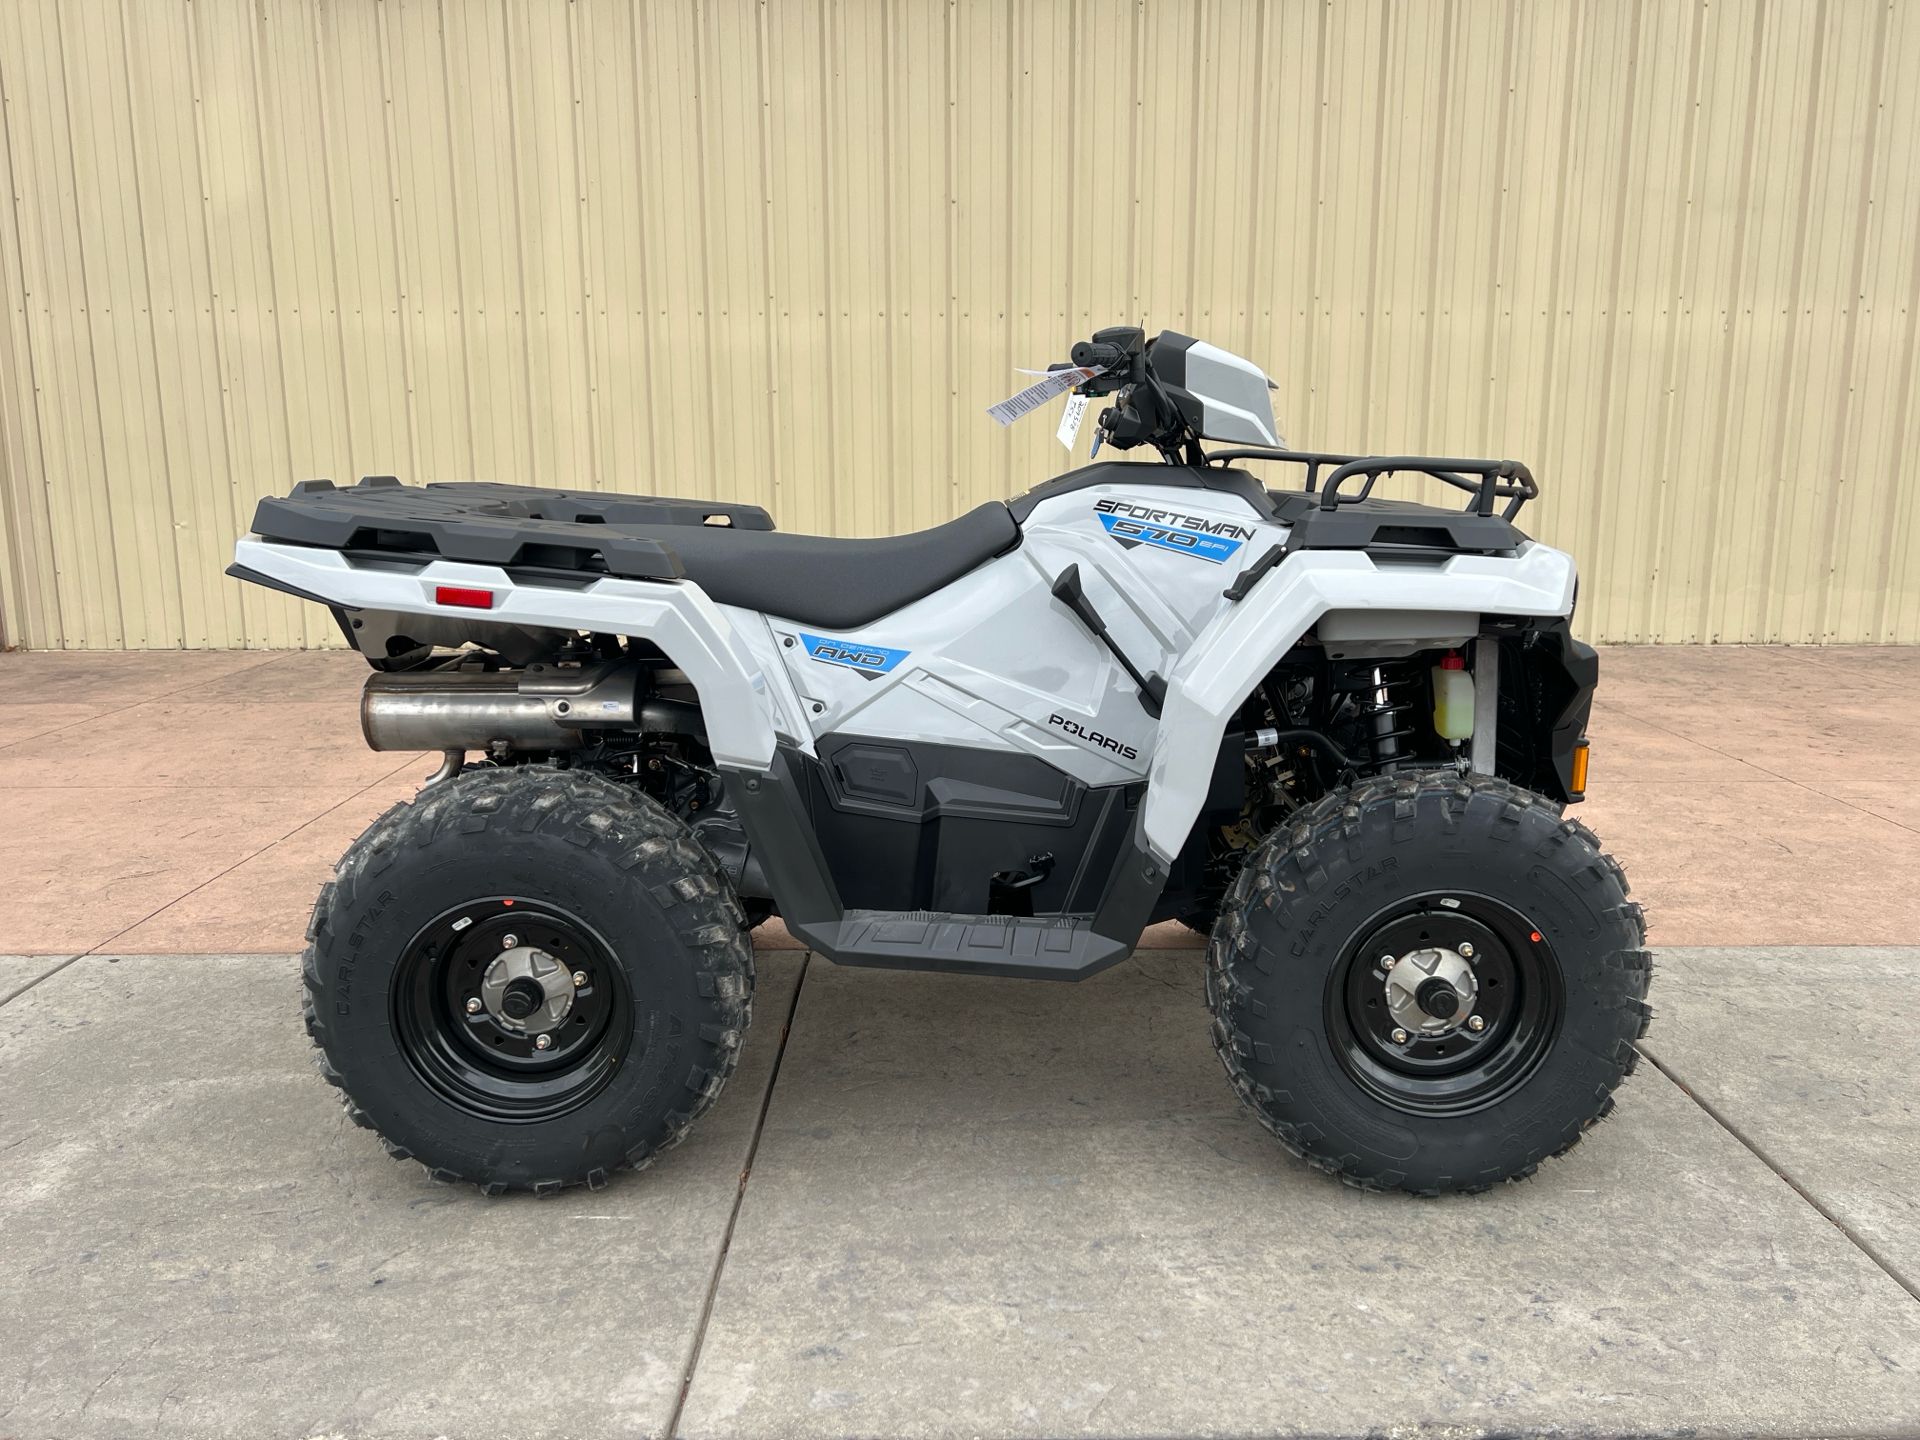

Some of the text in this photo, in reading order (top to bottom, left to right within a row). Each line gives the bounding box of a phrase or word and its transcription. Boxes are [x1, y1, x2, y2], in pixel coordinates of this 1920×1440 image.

[1093, 499, 1257, 541] SPORTSMAN
[1112, 521, 1229, 552] 570 EFI
[813, 645, 886, 666] AWD
[840, 643, 890, 656] DEMAND
[1048, 713, 1138, 760] POLARIS
[1288, 855, 1401, 958] CARLSTAR
[336, 887, 399, 1017] CARLSTAR
